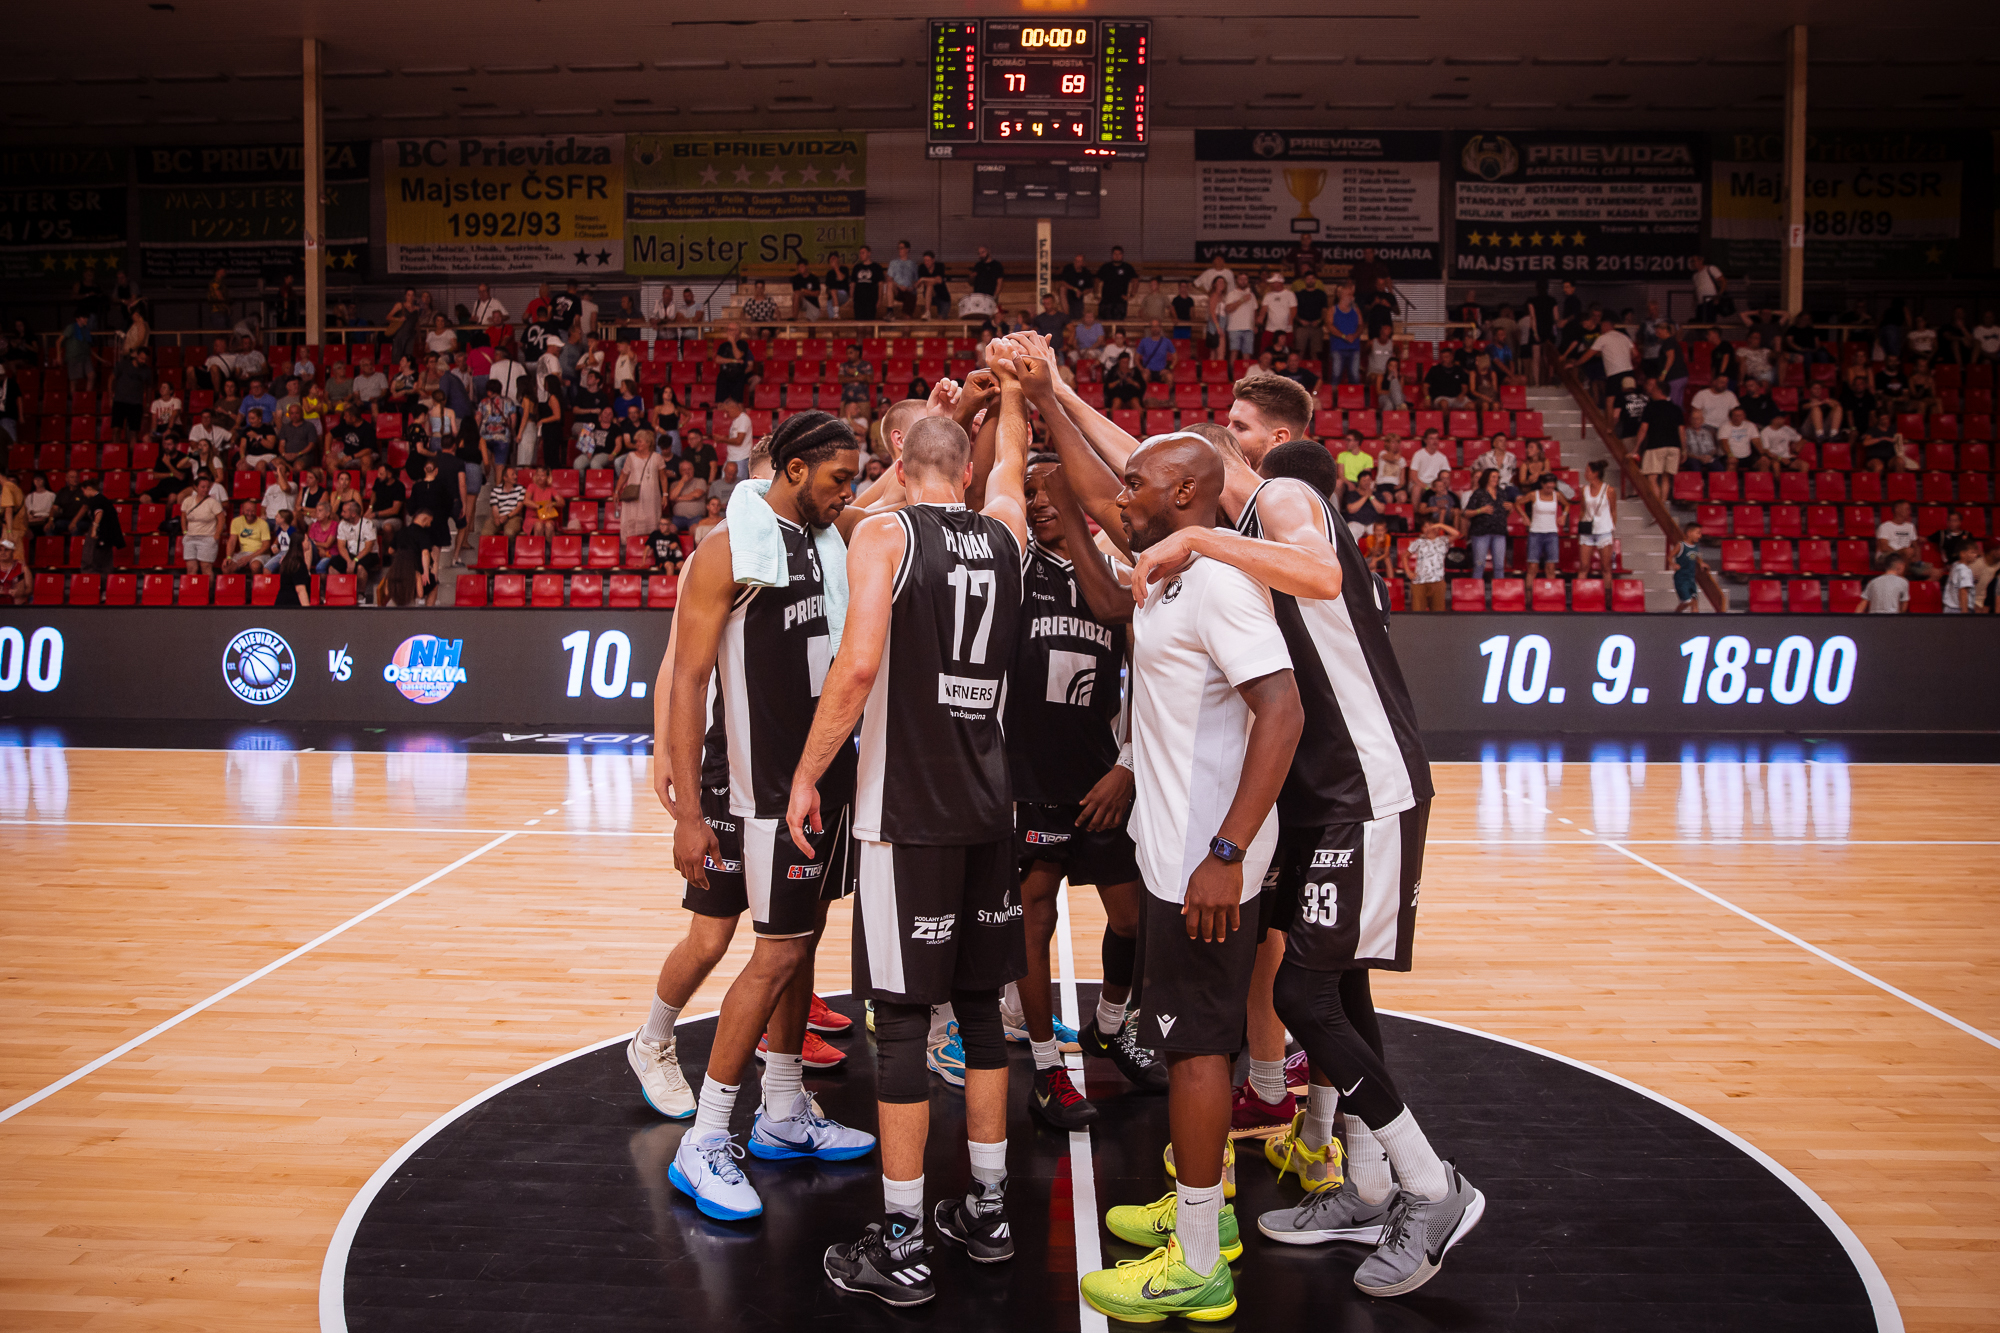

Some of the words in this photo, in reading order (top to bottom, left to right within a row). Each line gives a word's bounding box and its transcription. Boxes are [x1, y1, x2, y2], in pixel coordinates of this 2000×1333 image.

[1021, 28, 1072, 47] 00:00
[992, 58, 1026, 66] DOMÁCI
[1052, 59, 1084, 68] HOSTIA
[1004, 74, 1026, 92] 77
[1061, 74, 1086, 93] 69
[1000, 122, 1010, 137] 5
[1032, 122, 1043, 137] 4
[1072, 123, 1084, 137] 4
[397, 140, 448, 168] BC
[458, 137, 611, 167] Prievidza
[673, 143, 708, 158] BC
[714, 140, 858, 157] PRIEVIDZA
[929, 146, 952, 156] LGR
[1289, 138, 1382, 149] PRIEVIDZA
[1528, 146, 1693, 163] PRIEVIDZA
[1734, 134, 1783, 161] BC
[152, 150, 194, 174] BC
[201, 146, 357, 173] PRIEVIZA
[401, 177, 511, 208] Majster
[521, 170, 608, 200] ČSFR
[1731, 172, 1843, 204] Majter
[1853, 166, 1942, 198] ČSSR
[448, 211, 561, 237] 1992/93
[816, 226, 856, 242] 2011
[1804, 210, 1892, 236] 88/89
[633, 234, 748, 270] Majster
[760, 233, 804, 264] SR
[816, 253, 859, 264] 212
[1457, 254, 1556, 272] MAJSTER
[1562, 255, 1590, 271] SR
[806, 548, 820, 582] 3
[789, 574, 806, 582] TNERS
[948, 564, 996, 664] 17
[232, 632, 285, 655] PRIEVIDZA
[1030, 616, 1112, 652] PRIEVIDZA
[328, 645, 353, 681] VS
[409, 638, 463, 668] NH
[561, 630, 648, 699] 10.
[383, 664, 467, 684] OSTRAVA
[1479, 634, 1566, 704] 10.
[1592, 634, 1650, 704] 9.
[1680, 634, 1858, 705] 18:00
[231, 676, 289, 700] BASKETBALL
[711, 820, 736, 832] ATTIS
[1302, 882, 1338, 927] 33
